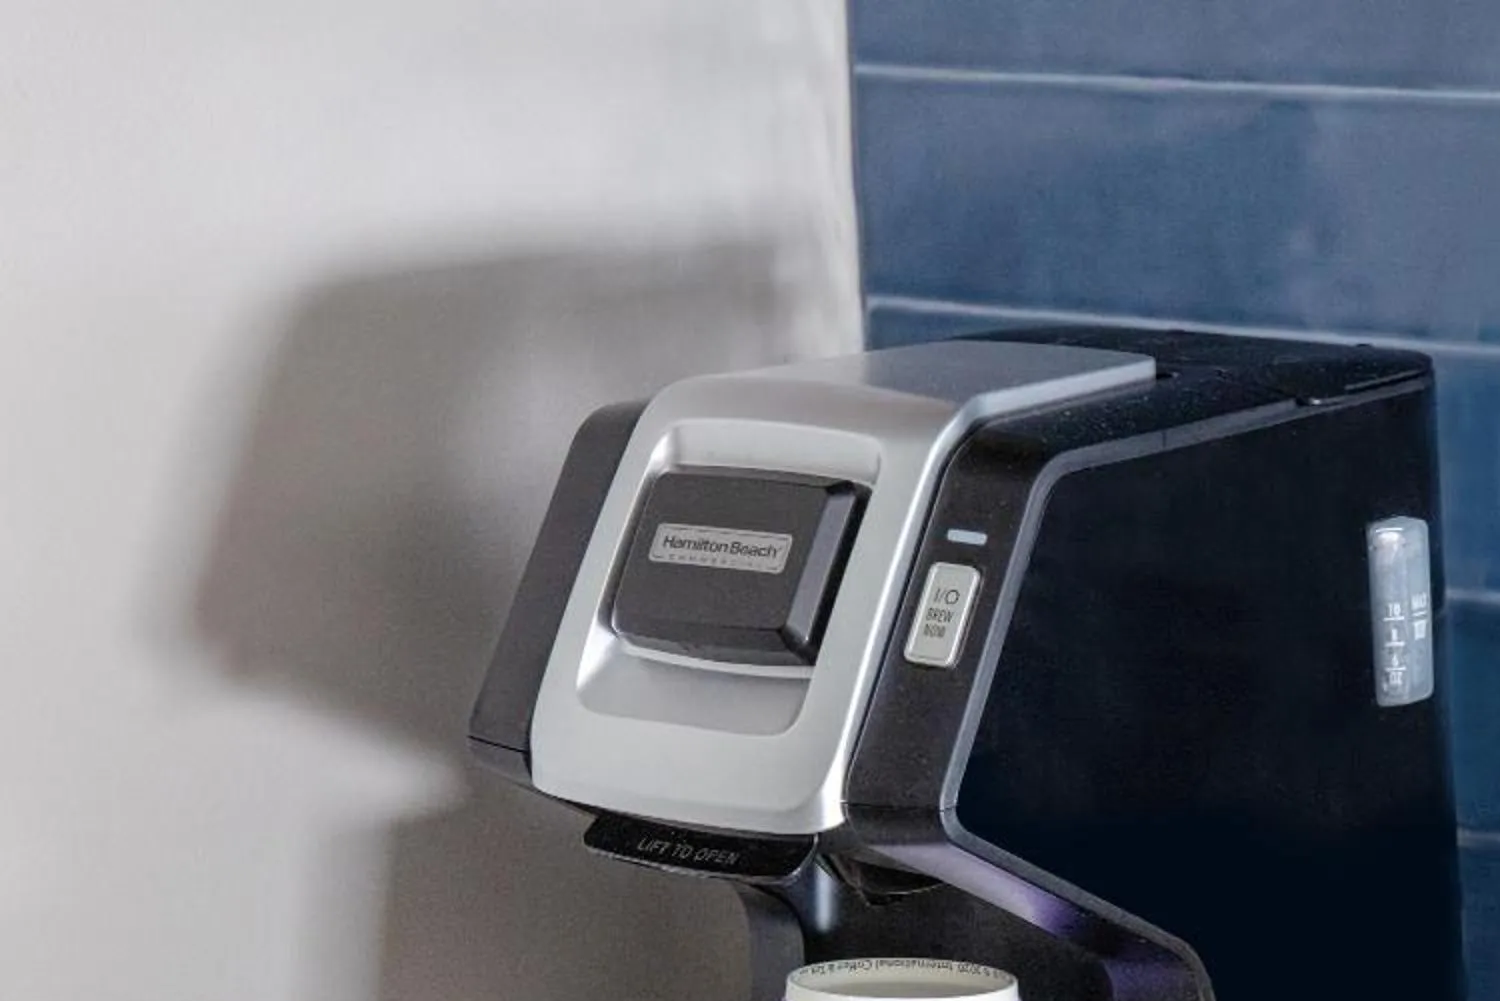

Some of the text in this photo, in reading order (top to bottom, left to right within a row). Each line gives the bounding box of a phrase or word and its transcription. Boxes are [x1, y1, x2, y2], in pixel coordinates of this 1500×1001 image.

[662, 534, 777, 559] Hamilton Beach
[926, 607, 954, 623] BREW
[636, 835, 741, 866] LIFT TO OPEN
